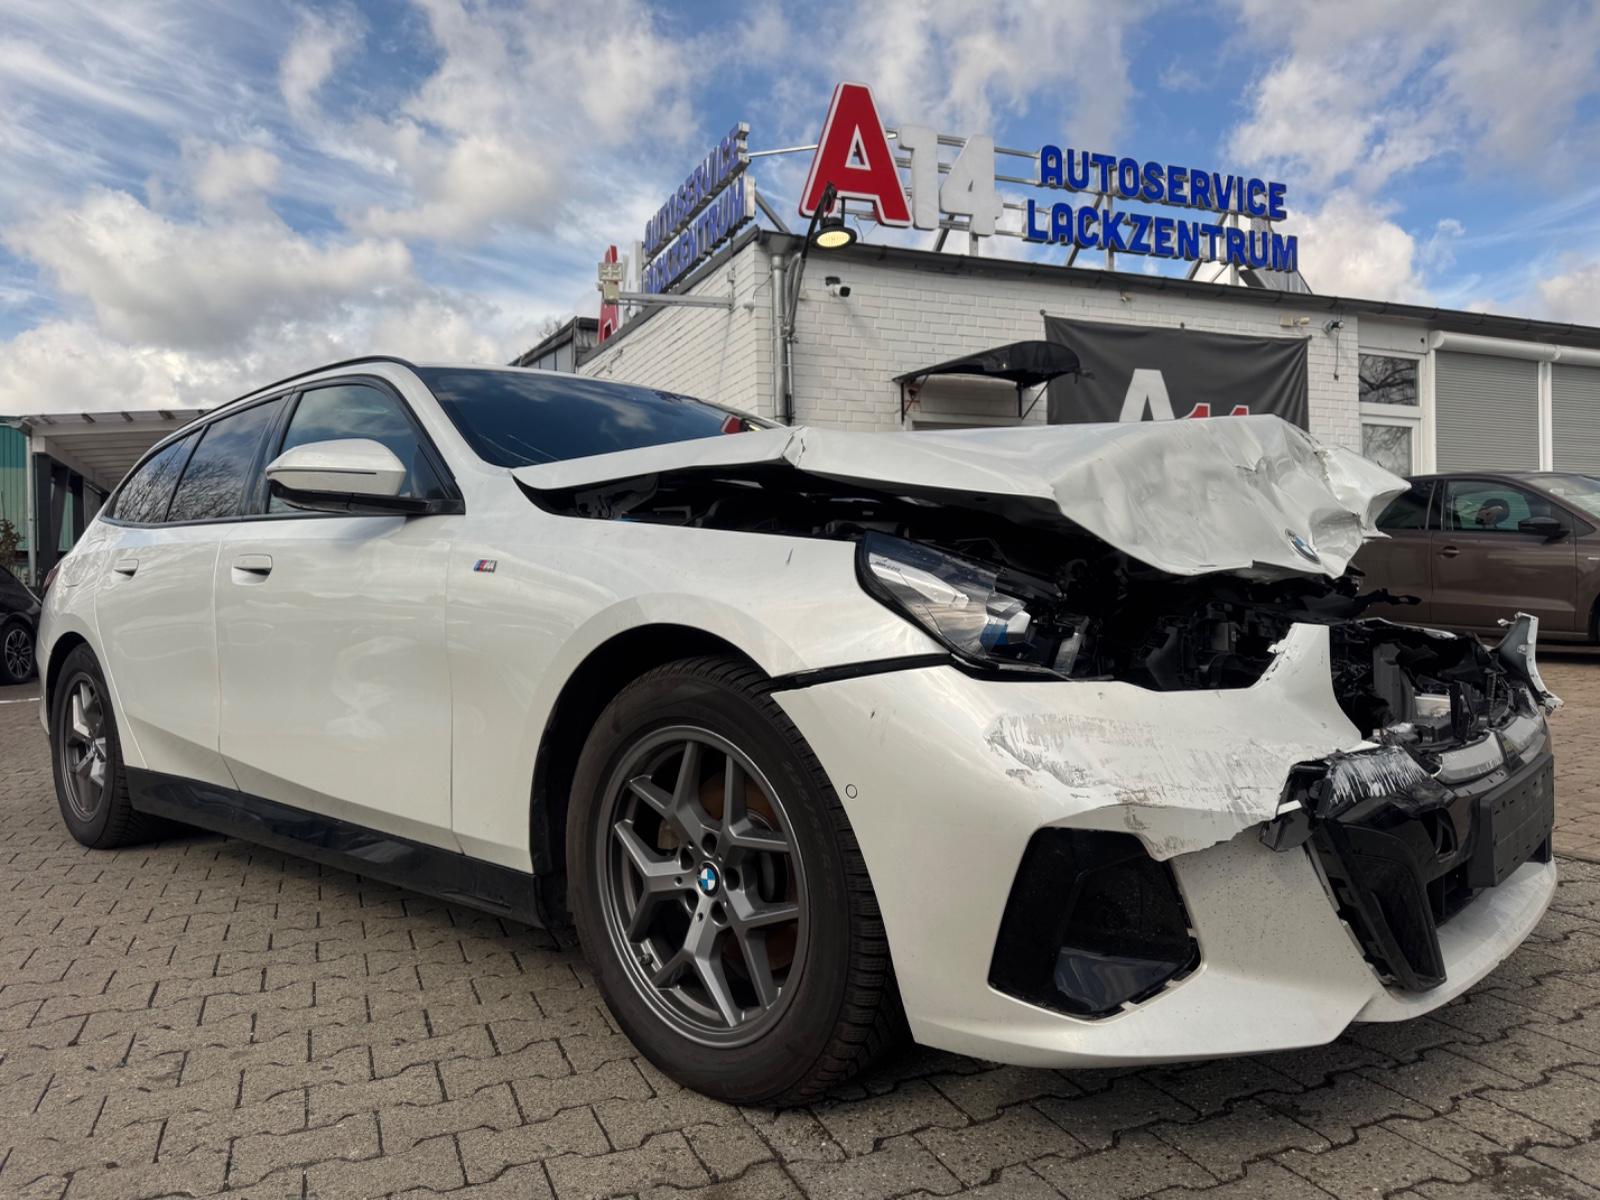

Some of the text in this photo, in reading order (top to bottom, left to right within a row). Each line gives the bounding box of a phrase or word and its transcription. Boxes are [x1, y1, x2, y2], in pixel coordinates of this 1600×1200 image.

[800, 81, 1000, 237] A14
[1039, 144, 1288, 221] AUTOSERVICE
[642, 171, 756, 295] ACKZENTRUM
[1026, 199, 1299, 273] LACKZENTRUM
